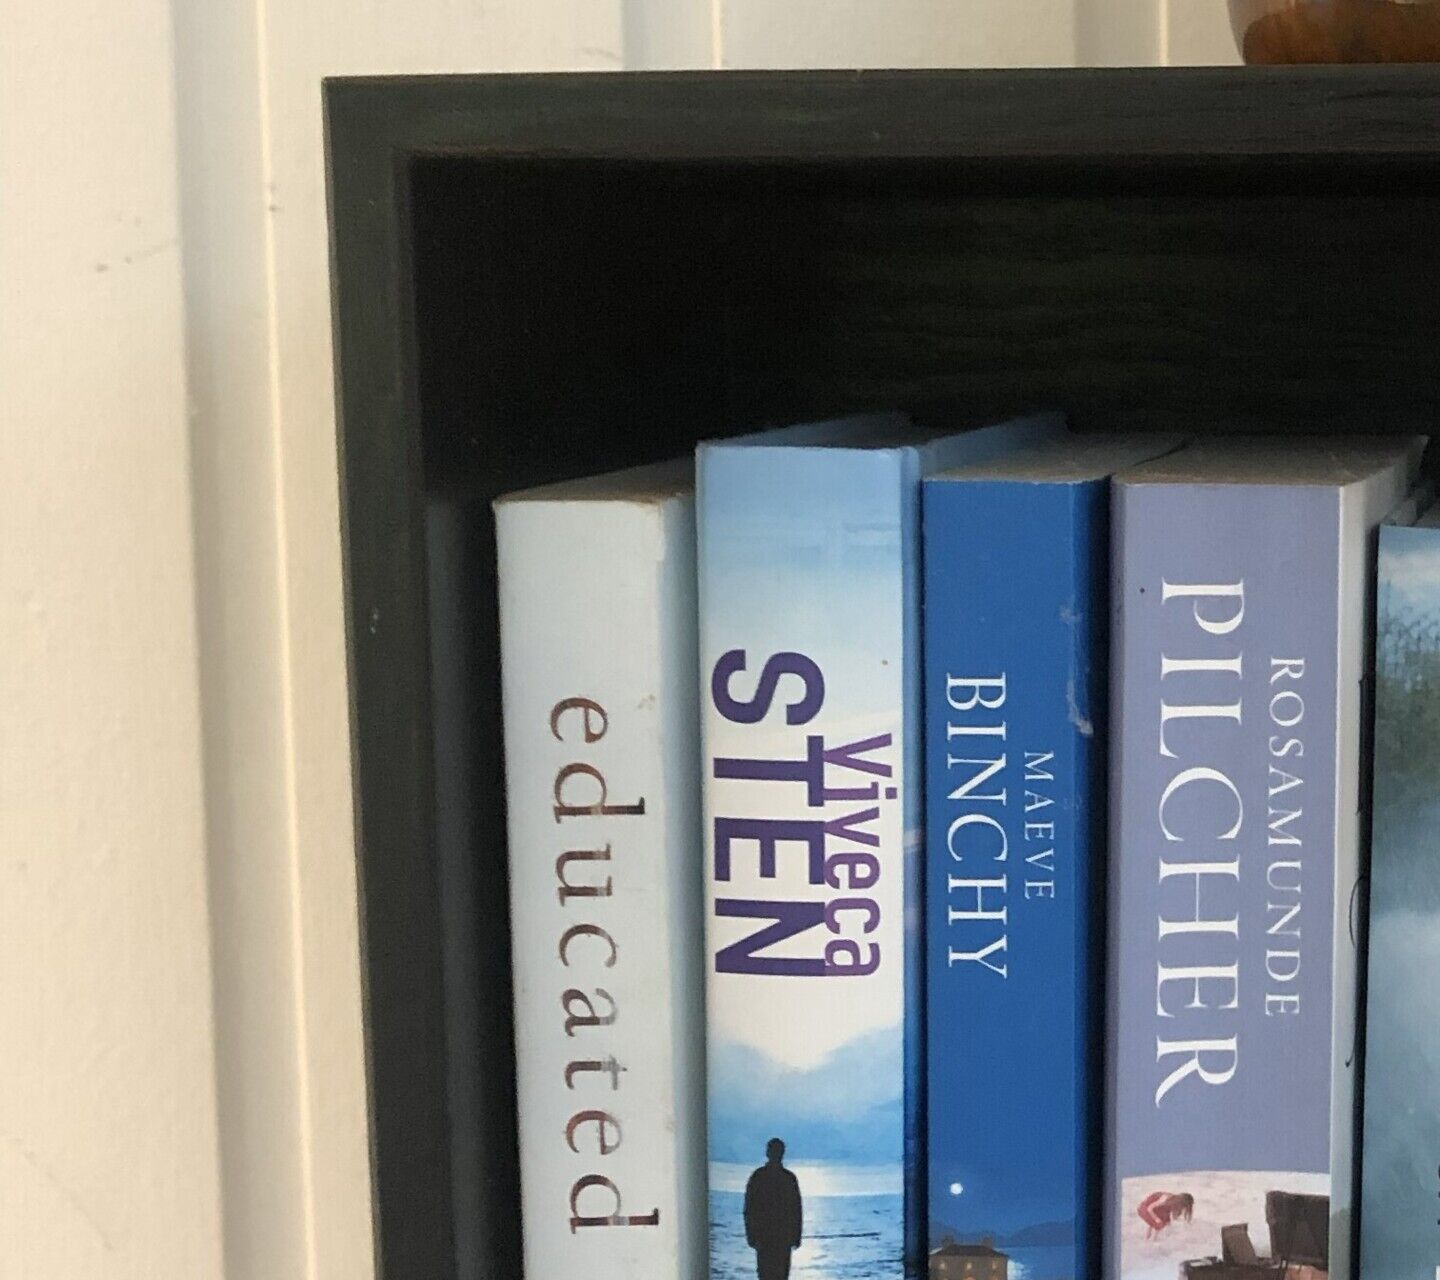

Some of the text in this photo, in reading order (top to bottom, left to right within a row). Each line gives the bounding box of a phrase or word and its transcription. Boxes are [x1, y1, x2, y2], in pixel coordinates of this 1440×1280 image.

[549, 697, 661, 1234] educated
[711, 648, 826, 977] STEN
[823, 732, 898, 977] Viveca
[946, 673, 1008, 978] BINCHY
[1024, 751, 1055, 901] MAEVE
[1155, 577, 1245, 1108] PILCHER
[1265, 656, 1305, 1017] ROSAMUNDE
